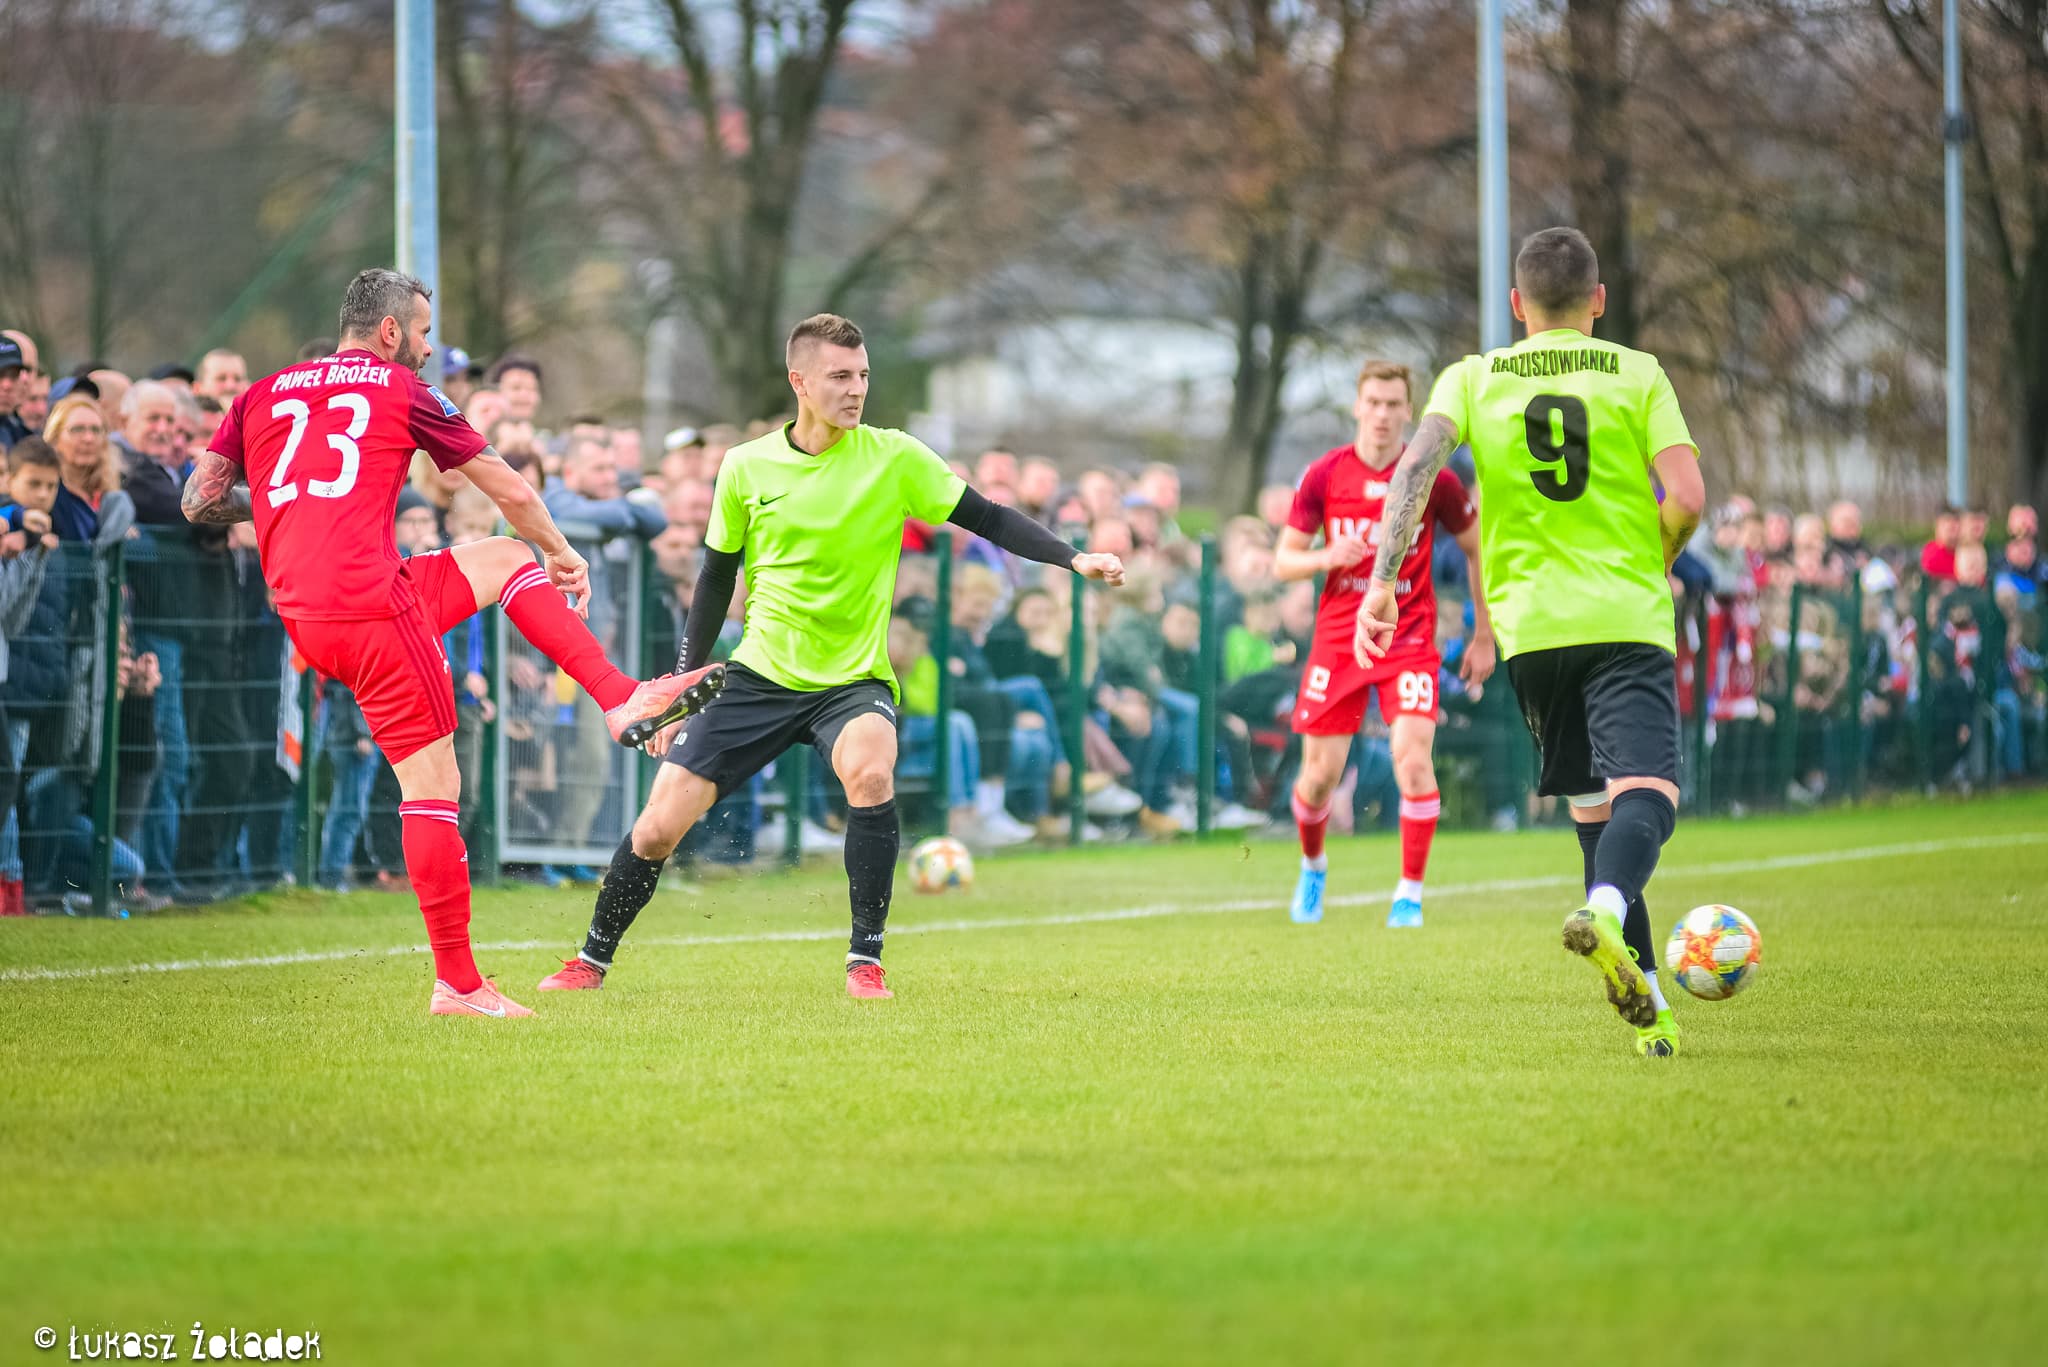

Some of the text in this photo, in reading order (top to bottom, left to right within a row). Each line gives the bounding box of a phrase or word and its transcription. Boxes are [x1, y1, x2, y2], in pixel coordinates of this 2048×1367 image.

[271, 368, 323, 393] PAWEŁ
[1491, 349, 1620, 378] RADZISZOWIANKA
[267, 393, 371, 509] 23
[1525, 393, 1591, 502] 9
[1399, 671, 1434, 711] 99
